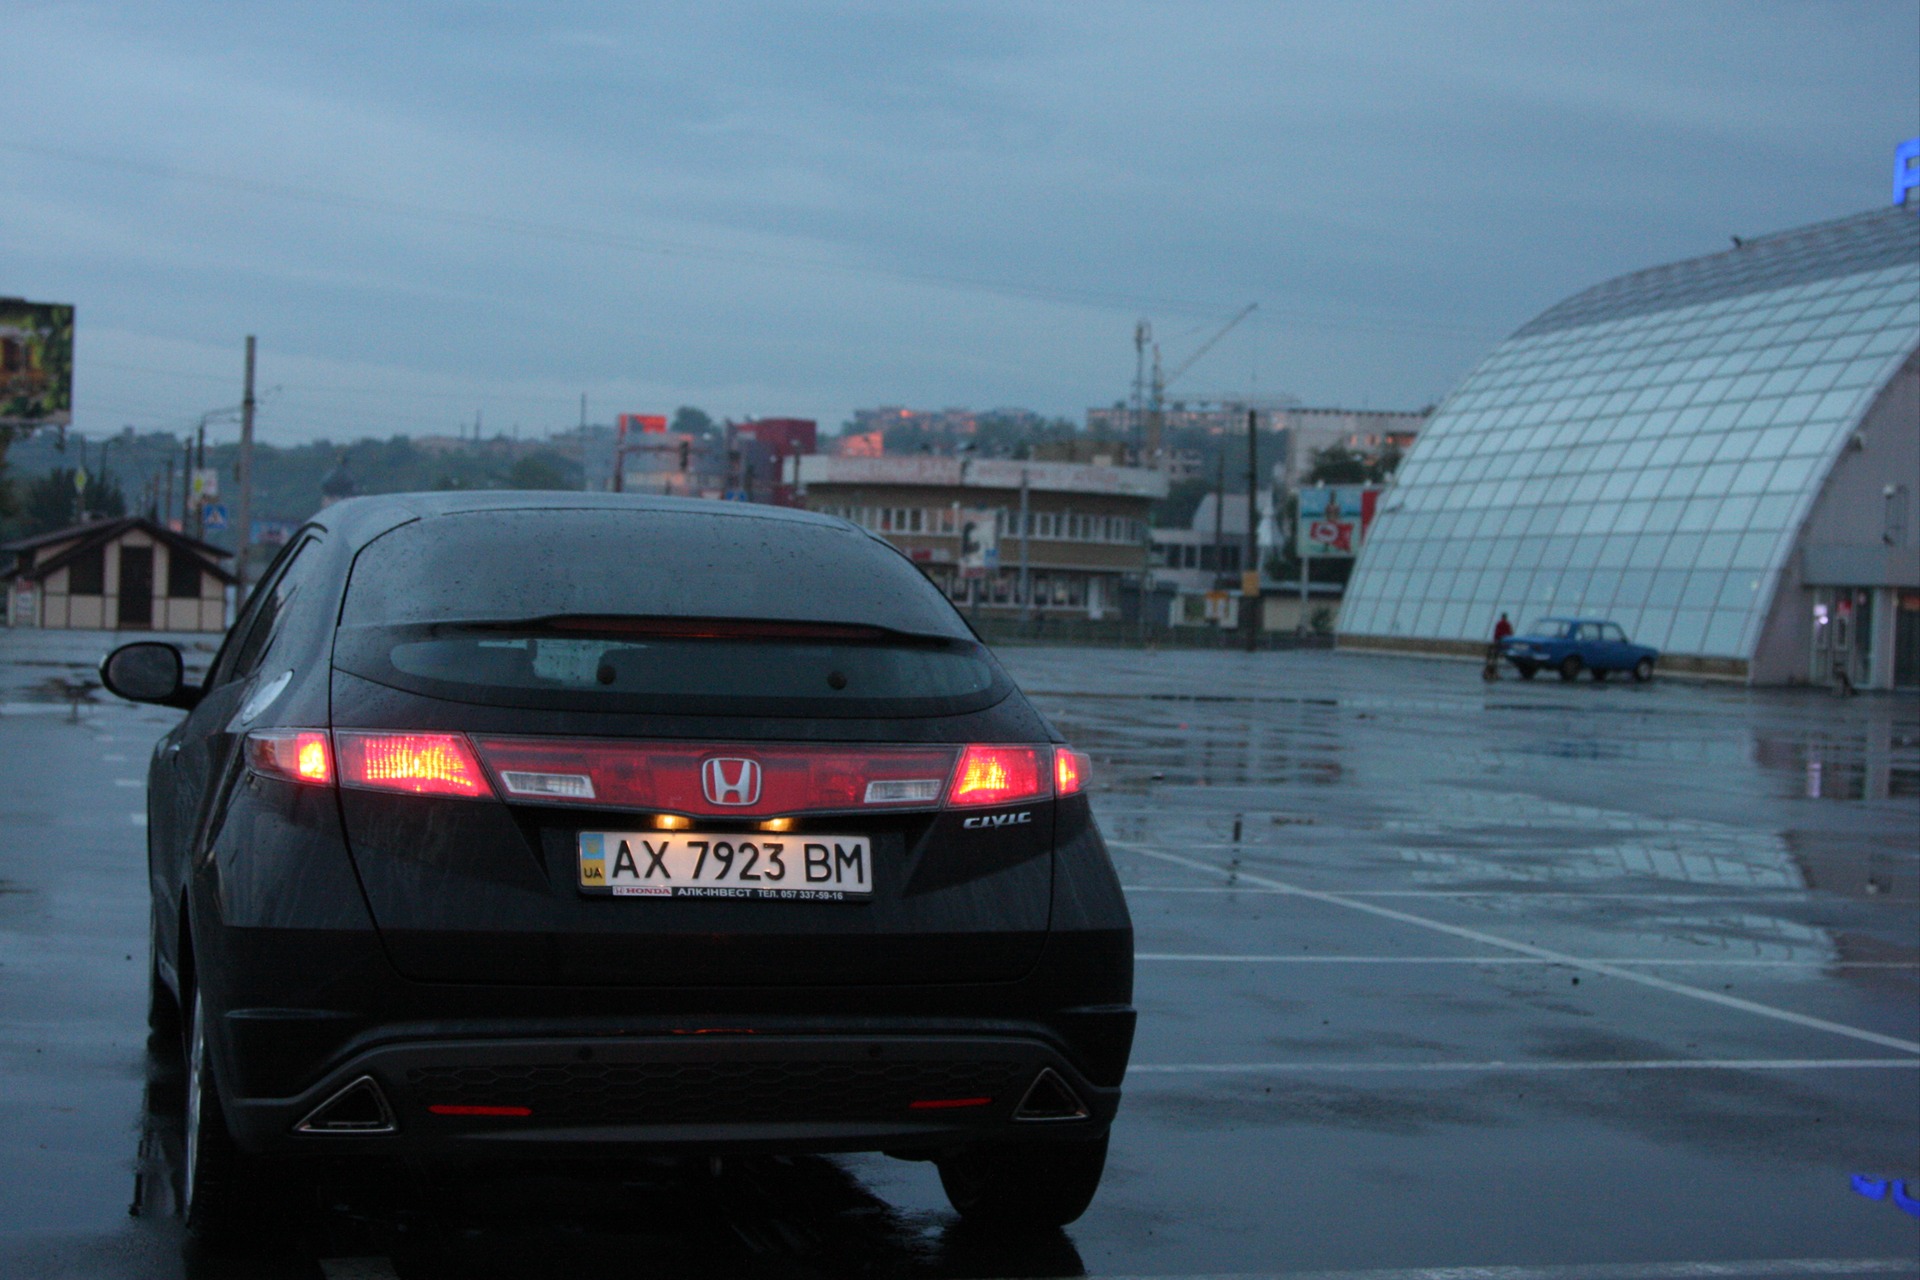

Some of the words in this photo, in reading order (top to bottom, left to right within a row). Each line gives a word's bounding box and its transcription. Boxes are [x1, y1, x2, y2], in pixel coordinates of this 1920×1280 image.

[963, 811, 1032, 829] CIVIC
[612, 840, 671, 879] AX
[687, 841, 786, 882] 7923
[803, 843, 864, 884] BM
[583, 867, 603, 879] UA
[626, 887, 671, 895] HONDA
[781, 890, 797, 899] 057
[799, 890, 844, 900] 337-59-16
